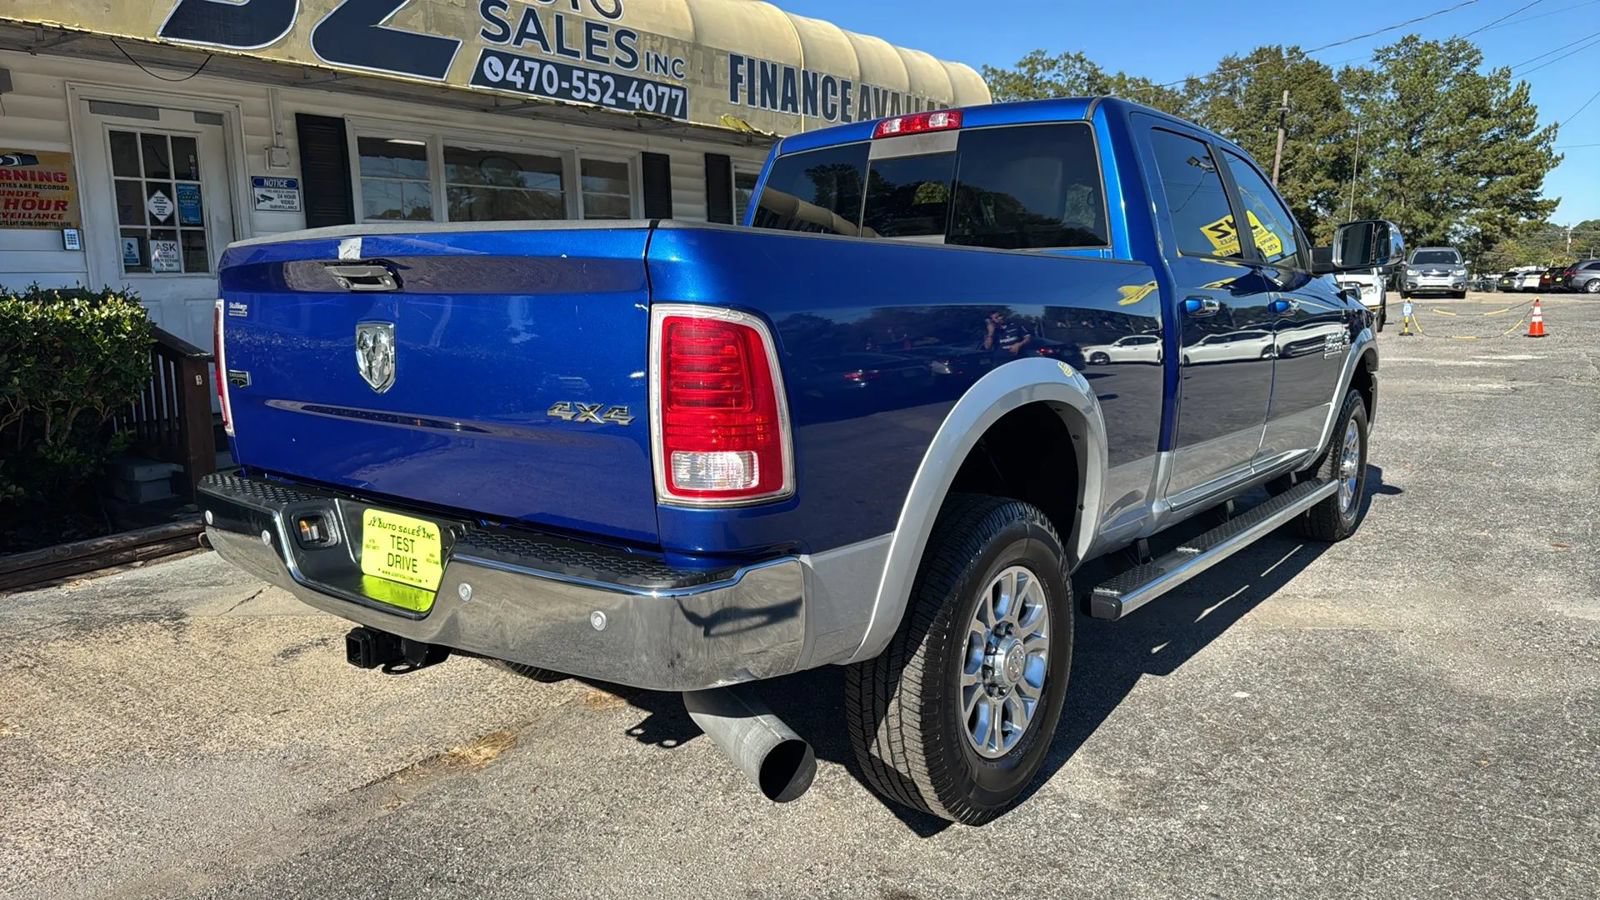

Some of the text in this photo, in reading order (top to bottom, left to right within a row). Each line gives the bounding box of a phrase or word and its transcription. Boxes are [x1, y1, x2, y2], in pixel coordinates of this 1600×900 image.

[479, 0, 639, 70] SALES
[645, 51, 685, 79] INC
[505, 58, 684, 117] 470-552-4077
[729, 53, 852, 122] FINANCE
[263, 178, 289, 189] NOTICE
[4, 198, 69, 212] HOUR
[398, 525, 421, 537] SALES
[389, 534, 415, 554] TEST
[387, 552, 418, 574] DRIVE
